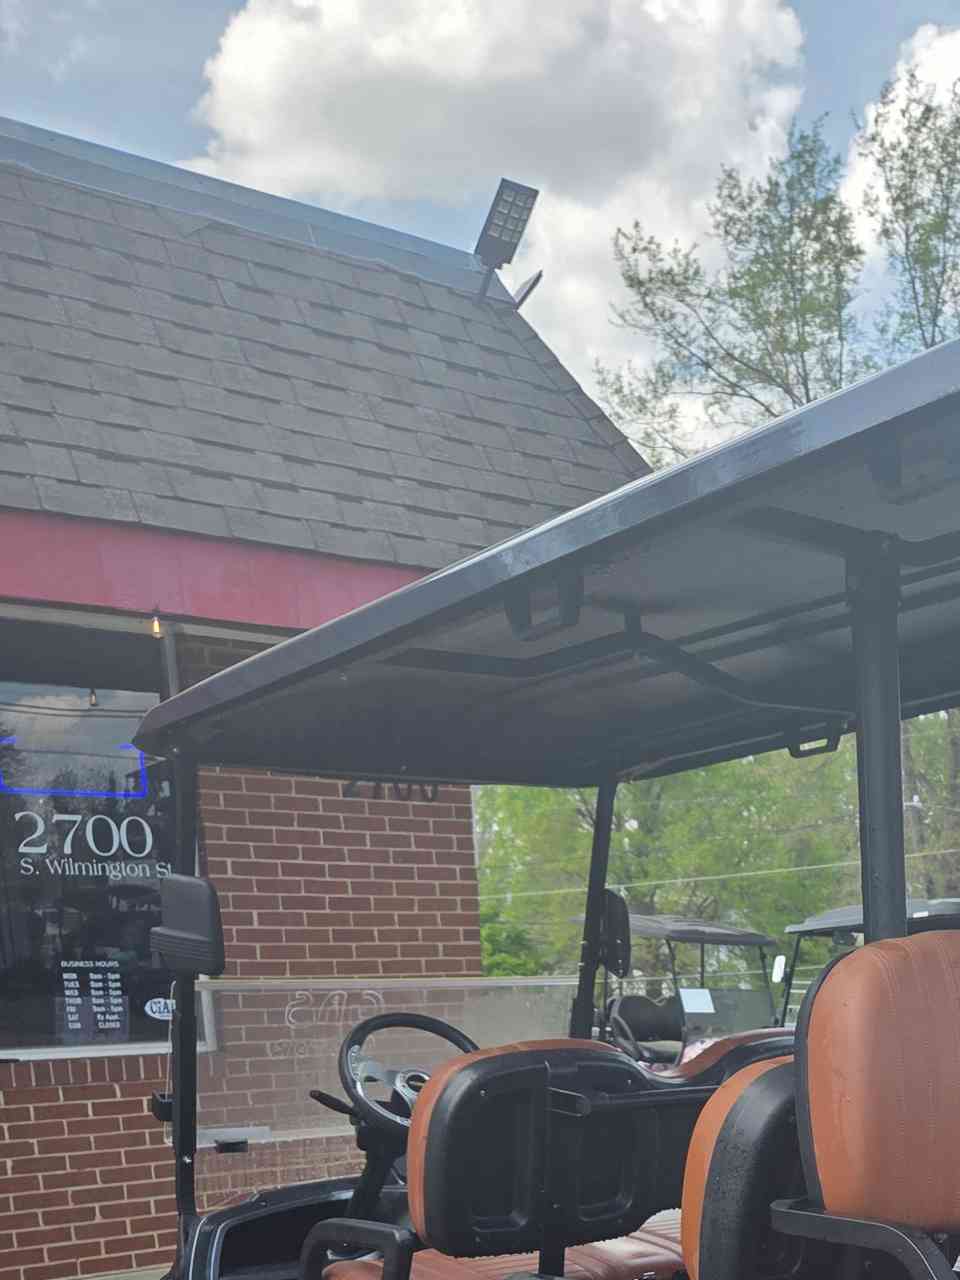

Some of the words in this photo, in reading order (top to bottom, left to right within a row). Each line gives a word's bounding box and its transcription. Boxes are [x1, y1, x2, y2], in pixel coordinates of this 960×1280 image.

[14, 811, 153, 858] 2700
[20, 857, 40, 875] S.
[45, 857, 150, 880] Wilmington
[60, 960, 94, 968] BUSINESS
[98, 1021, 121, 1029] CLOSED
